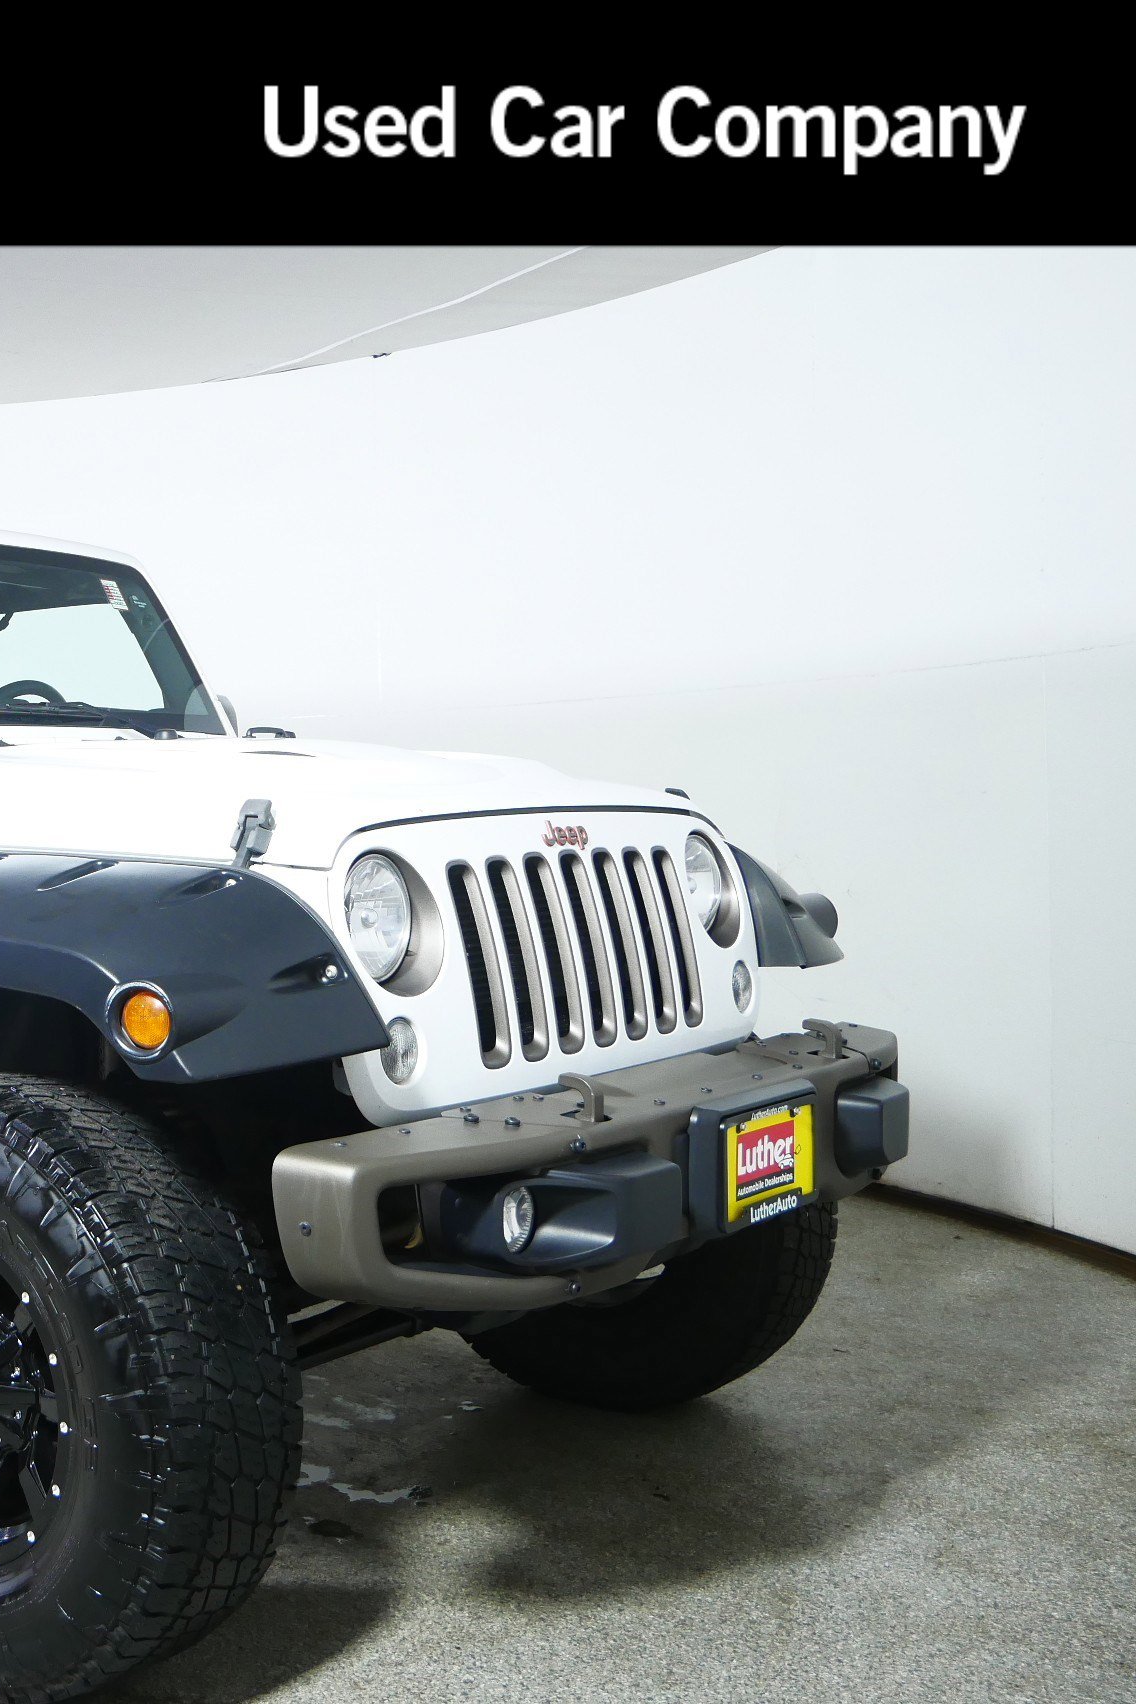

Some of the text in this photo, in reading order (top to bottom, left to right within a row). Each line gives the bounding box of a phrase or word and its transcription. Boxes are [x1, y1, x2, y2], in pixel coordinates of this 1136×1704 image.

[541, 820, 588, 850] Jeep
[737, 1135, 793, 1176] Luther
[737, 1172, 793, 1197] Automobile Dealerships
[750, 1195, 797, 1223] LutherAuto
